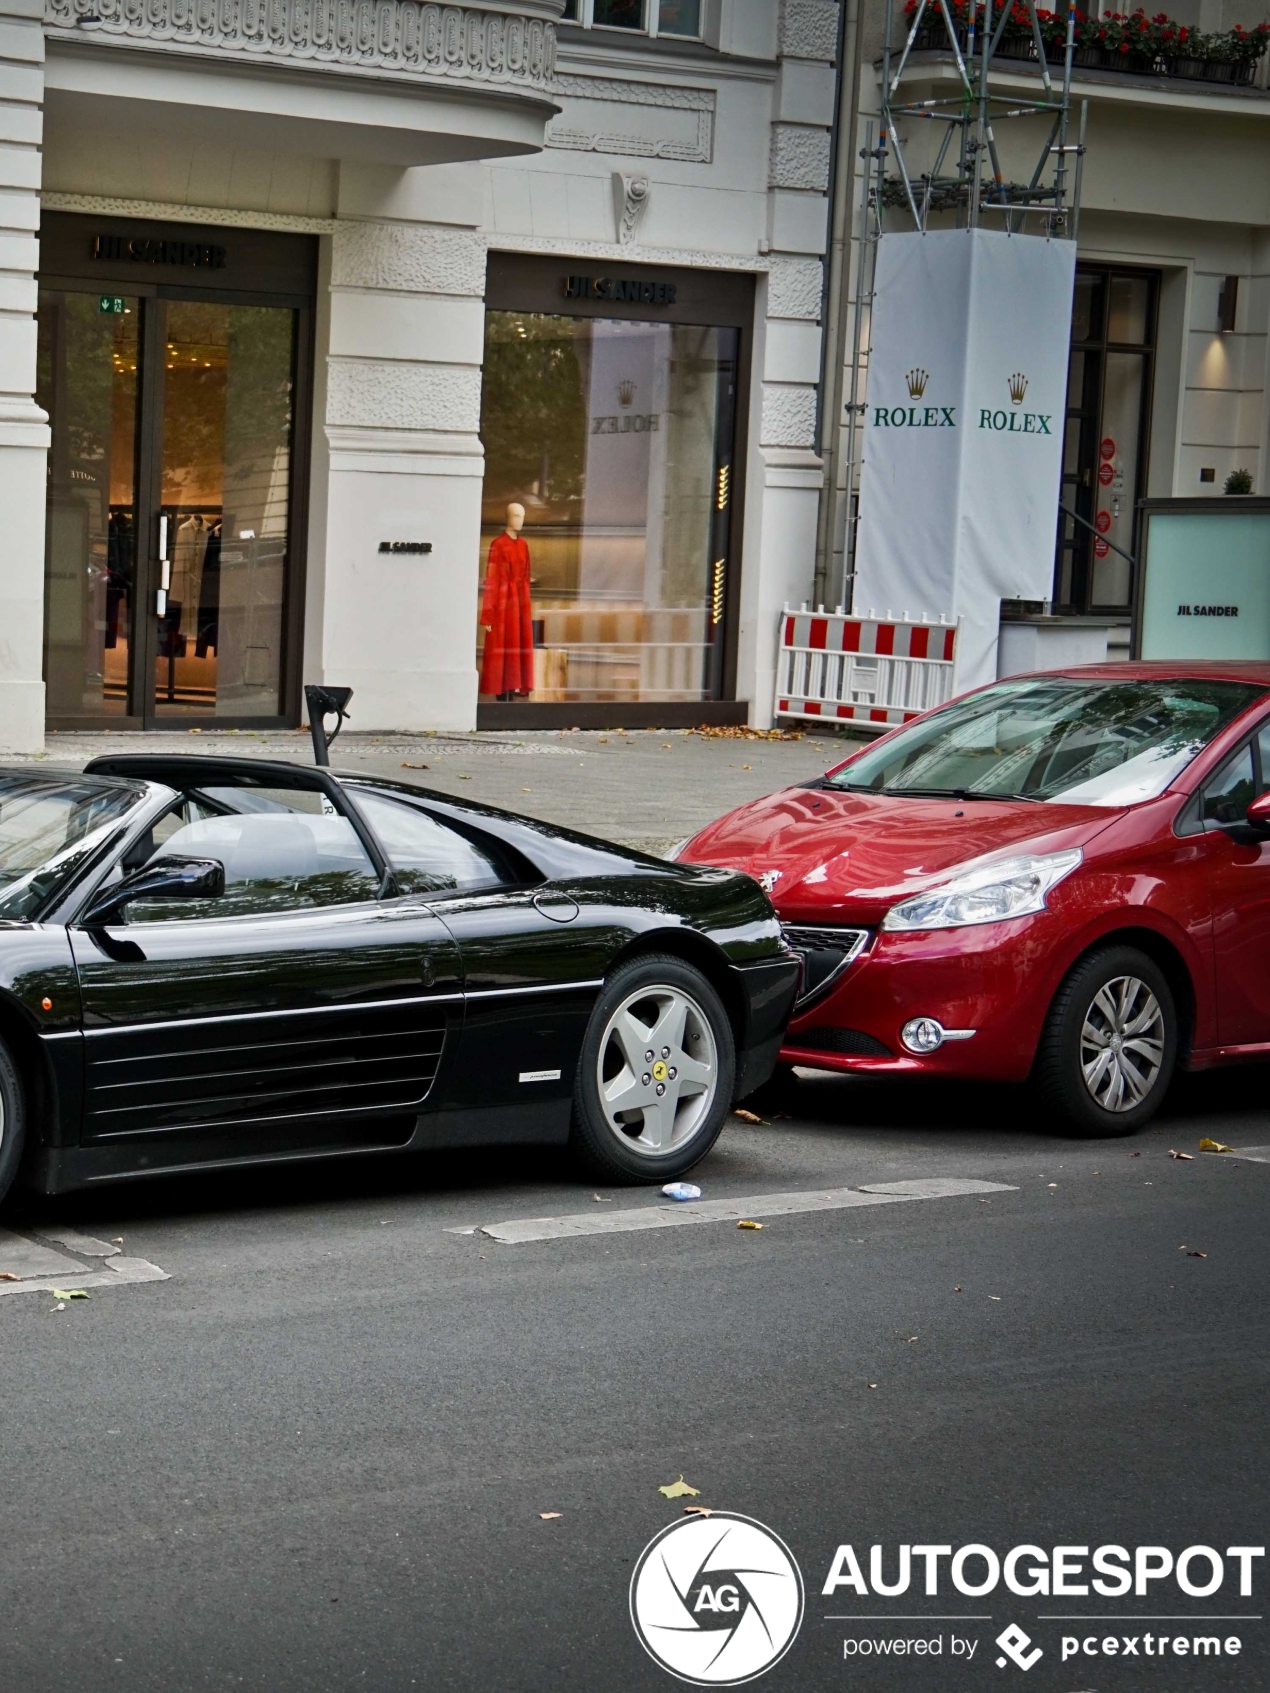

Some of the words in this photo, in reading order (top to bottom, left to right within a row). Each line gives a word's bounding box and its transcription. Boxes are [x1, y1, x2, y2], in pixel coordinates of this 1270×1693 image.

[94, 236, 129, 259] JIL
[129, 239, 227, 268] SANDER
[566, 276, 592, 298] JIL
[594, 277, 676, 304] SANDER
[873, 407, 956, 427] ROLEX
[979, 409, 1052, 435] ROLEX
[1177, 605, 1192, 616] JIL
[1193, 605, 1239, 617] SANDER
